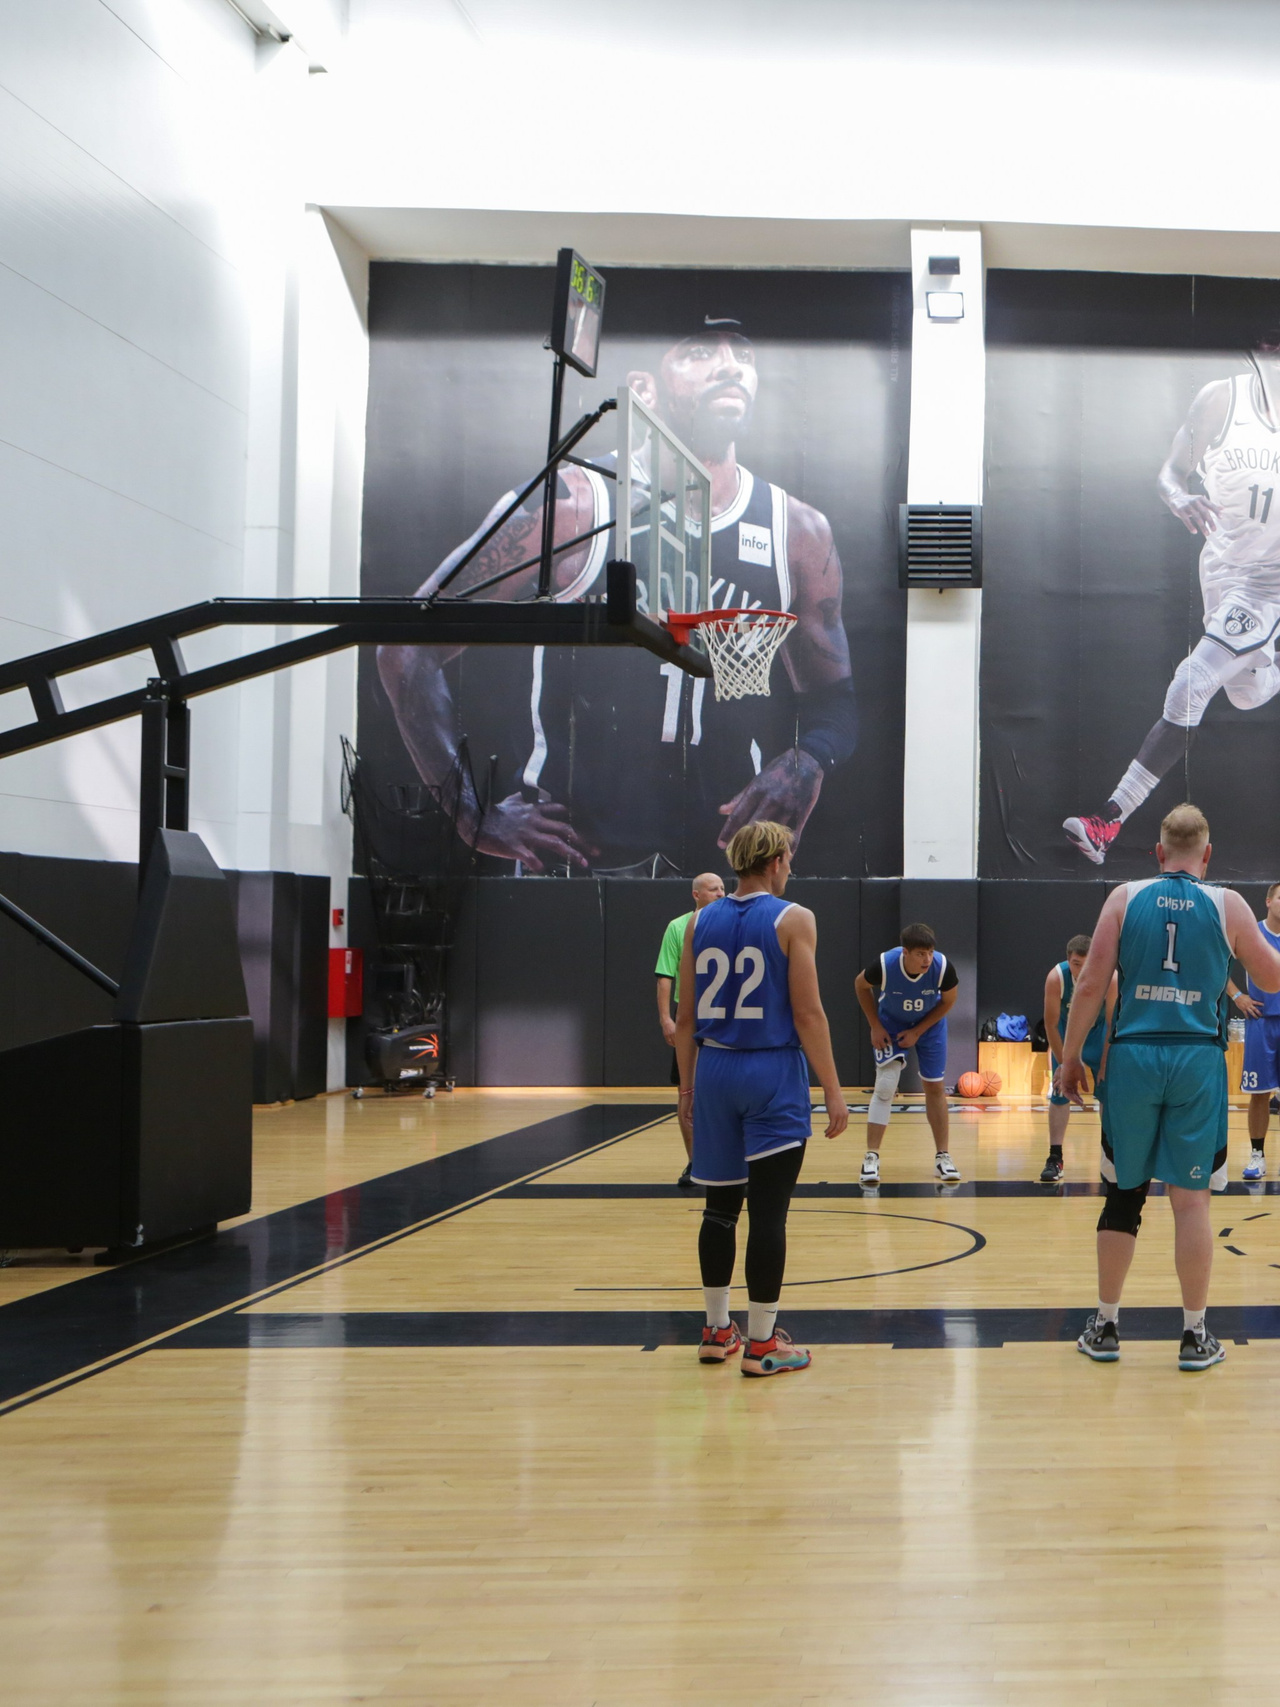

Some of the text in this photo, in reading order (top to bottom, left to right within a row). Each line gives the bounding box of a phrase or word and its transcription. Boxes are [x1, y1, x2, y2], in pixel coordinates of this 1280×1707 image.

[1248, 483, 1274, 524] 11
[741, 534, 768, 551] infor
[1228, 608, 1255, 631] NETS
[1156, 896, 1195, 911] СИБУР
[1162, 922, 1179, 973] 1
[695, 946, 765, 1019] 22
[903, 998, 924, 1012] 69
[1134, 984, 1202, 1006] СИБУР
[1242, 1070, 1258, 1088] 33
